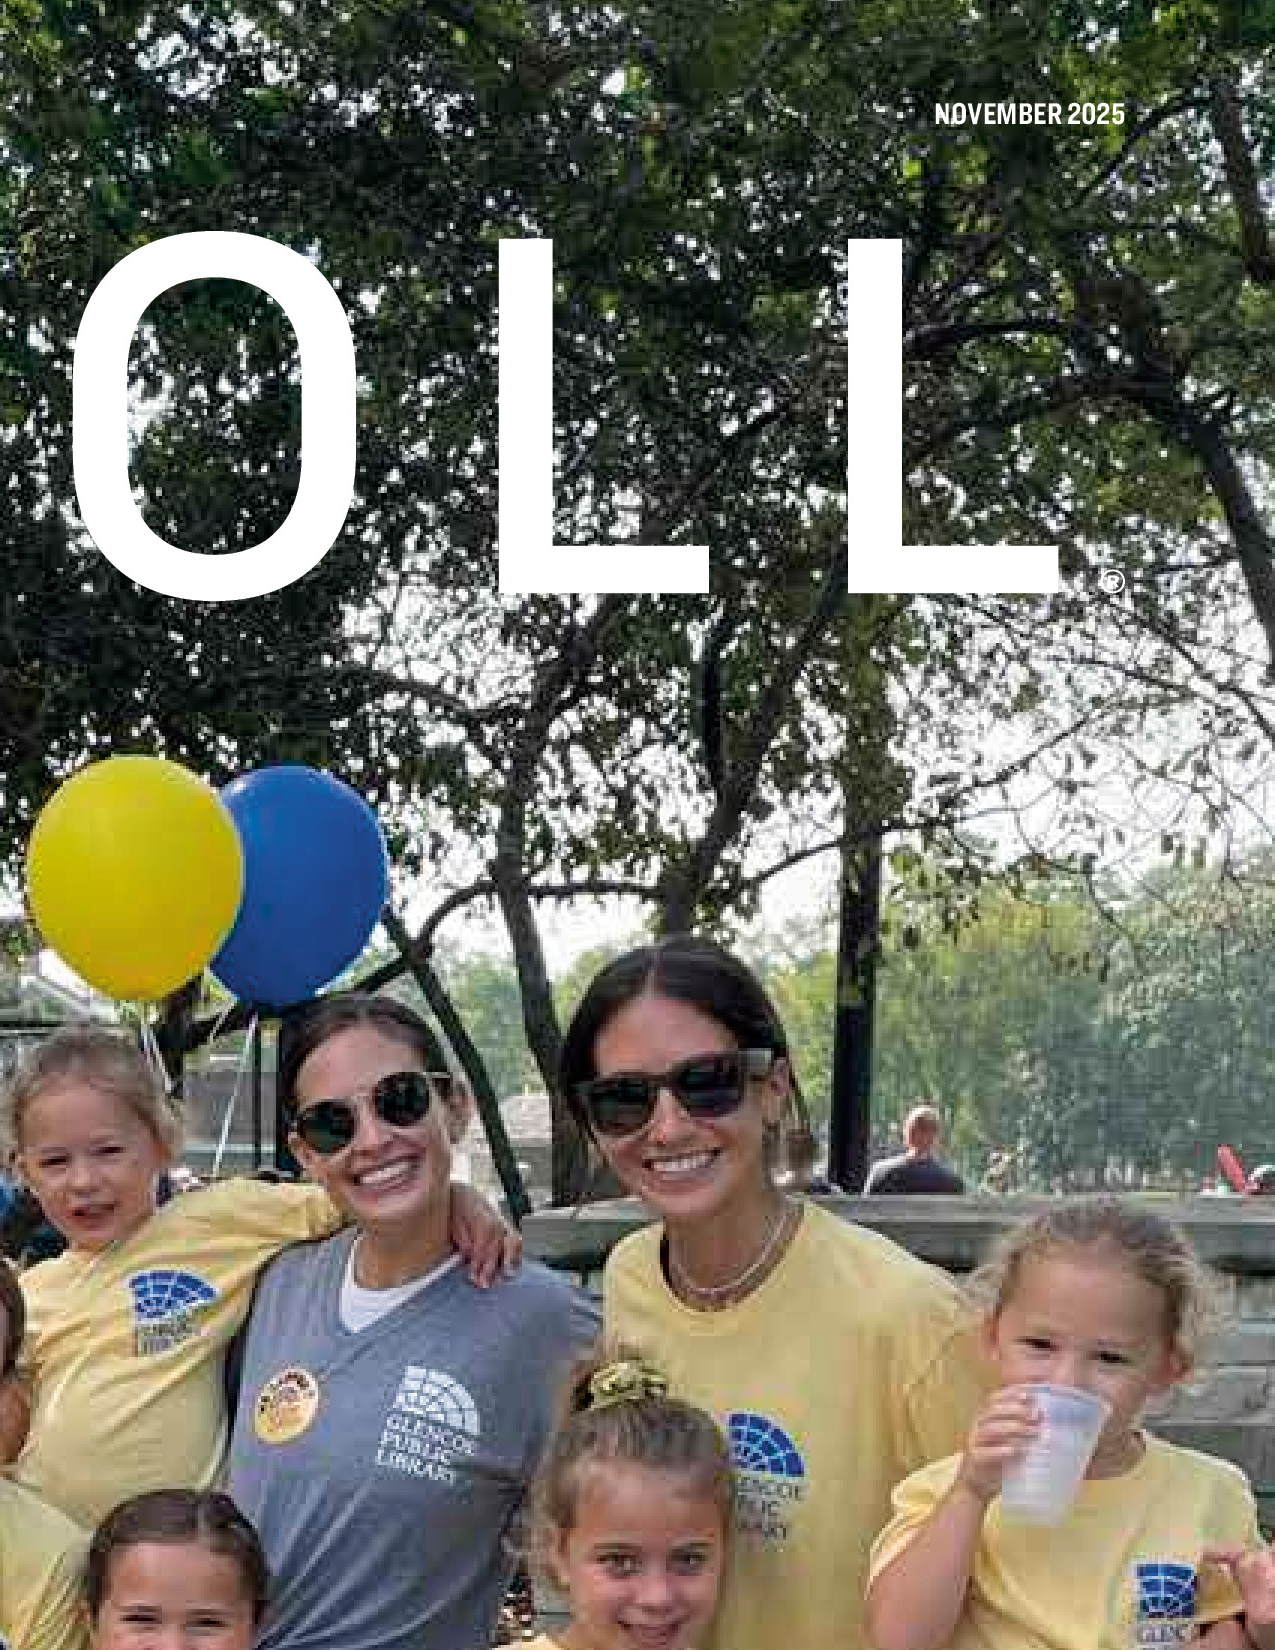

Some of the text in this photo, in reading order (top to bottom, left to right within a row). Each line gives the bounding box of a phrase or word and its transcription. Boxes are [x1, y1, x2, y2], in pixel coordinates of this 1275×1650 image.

[380, 1430, 451, 1465] PUBLIC
[386, 1413, 475, 1457] GLENCOE
[375, 1449, 455, 1486] LIBRARY
